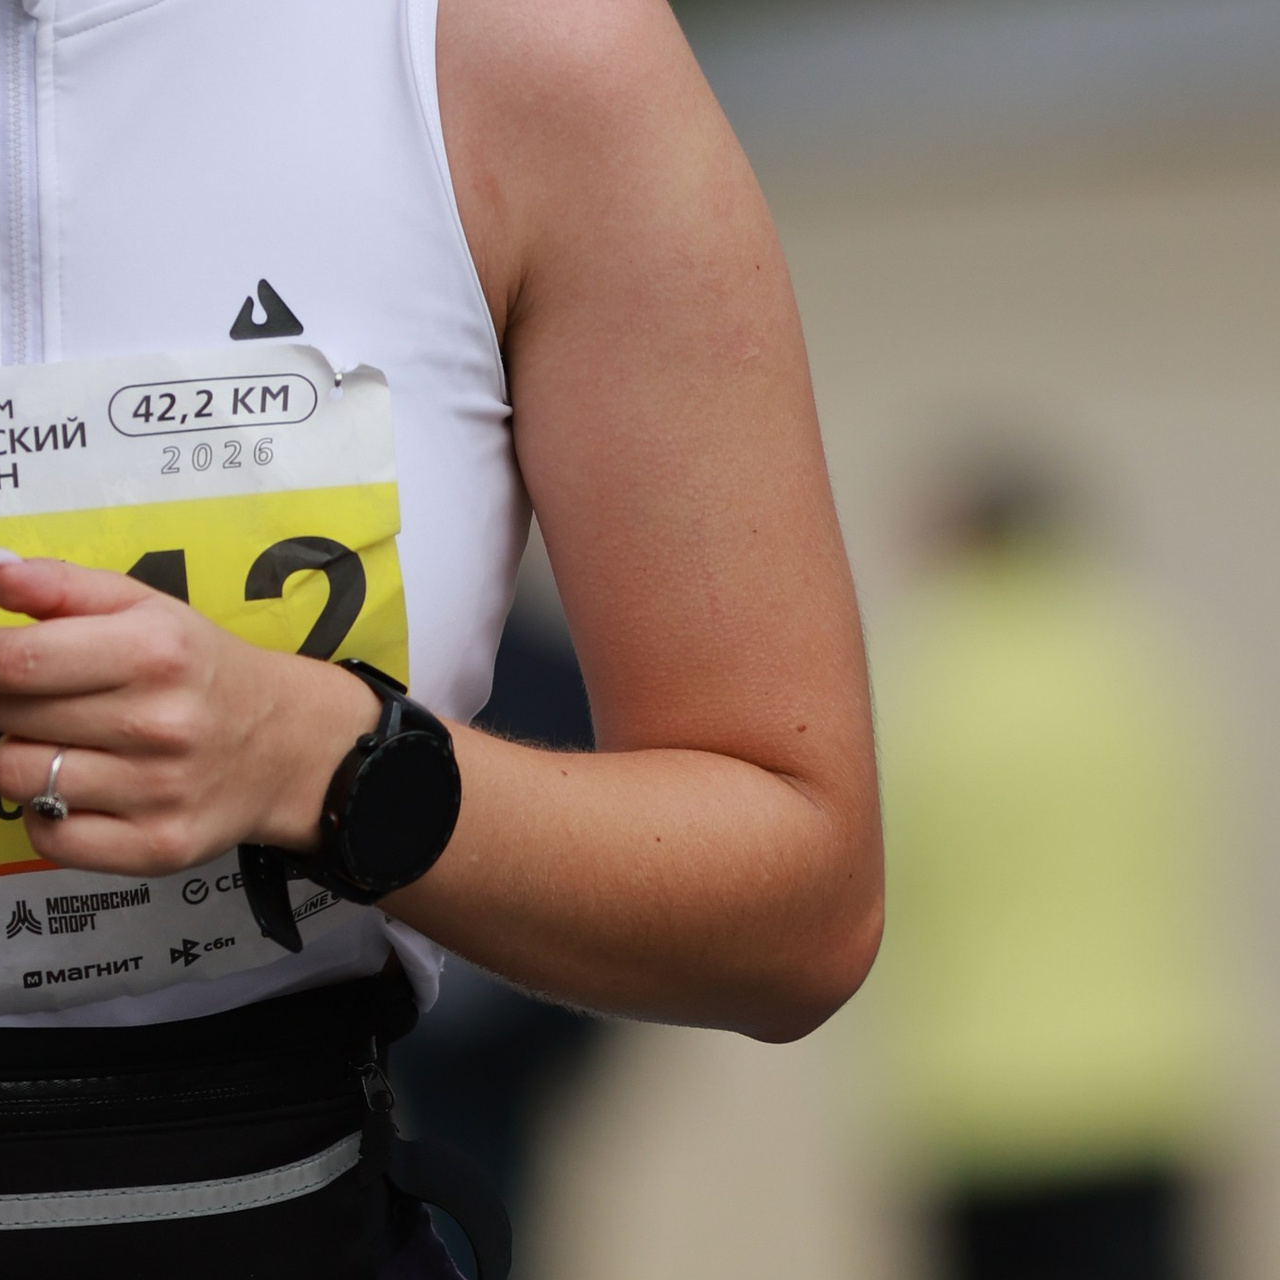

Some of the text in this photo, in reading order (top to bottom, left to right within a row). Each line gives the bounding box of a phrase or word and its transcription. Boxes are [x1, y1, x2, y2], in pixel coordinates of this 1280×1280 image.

[132, 389, 214, 424] 42,2
[160, 438, 274, 474] 2026
[46, 883, 151, 915] МОСКОВСКИЙ
[293, 893, 330, 918] LINE
[48, 913, 97, 935] СПОРТ
[203, 937, 236, 952] сбп
